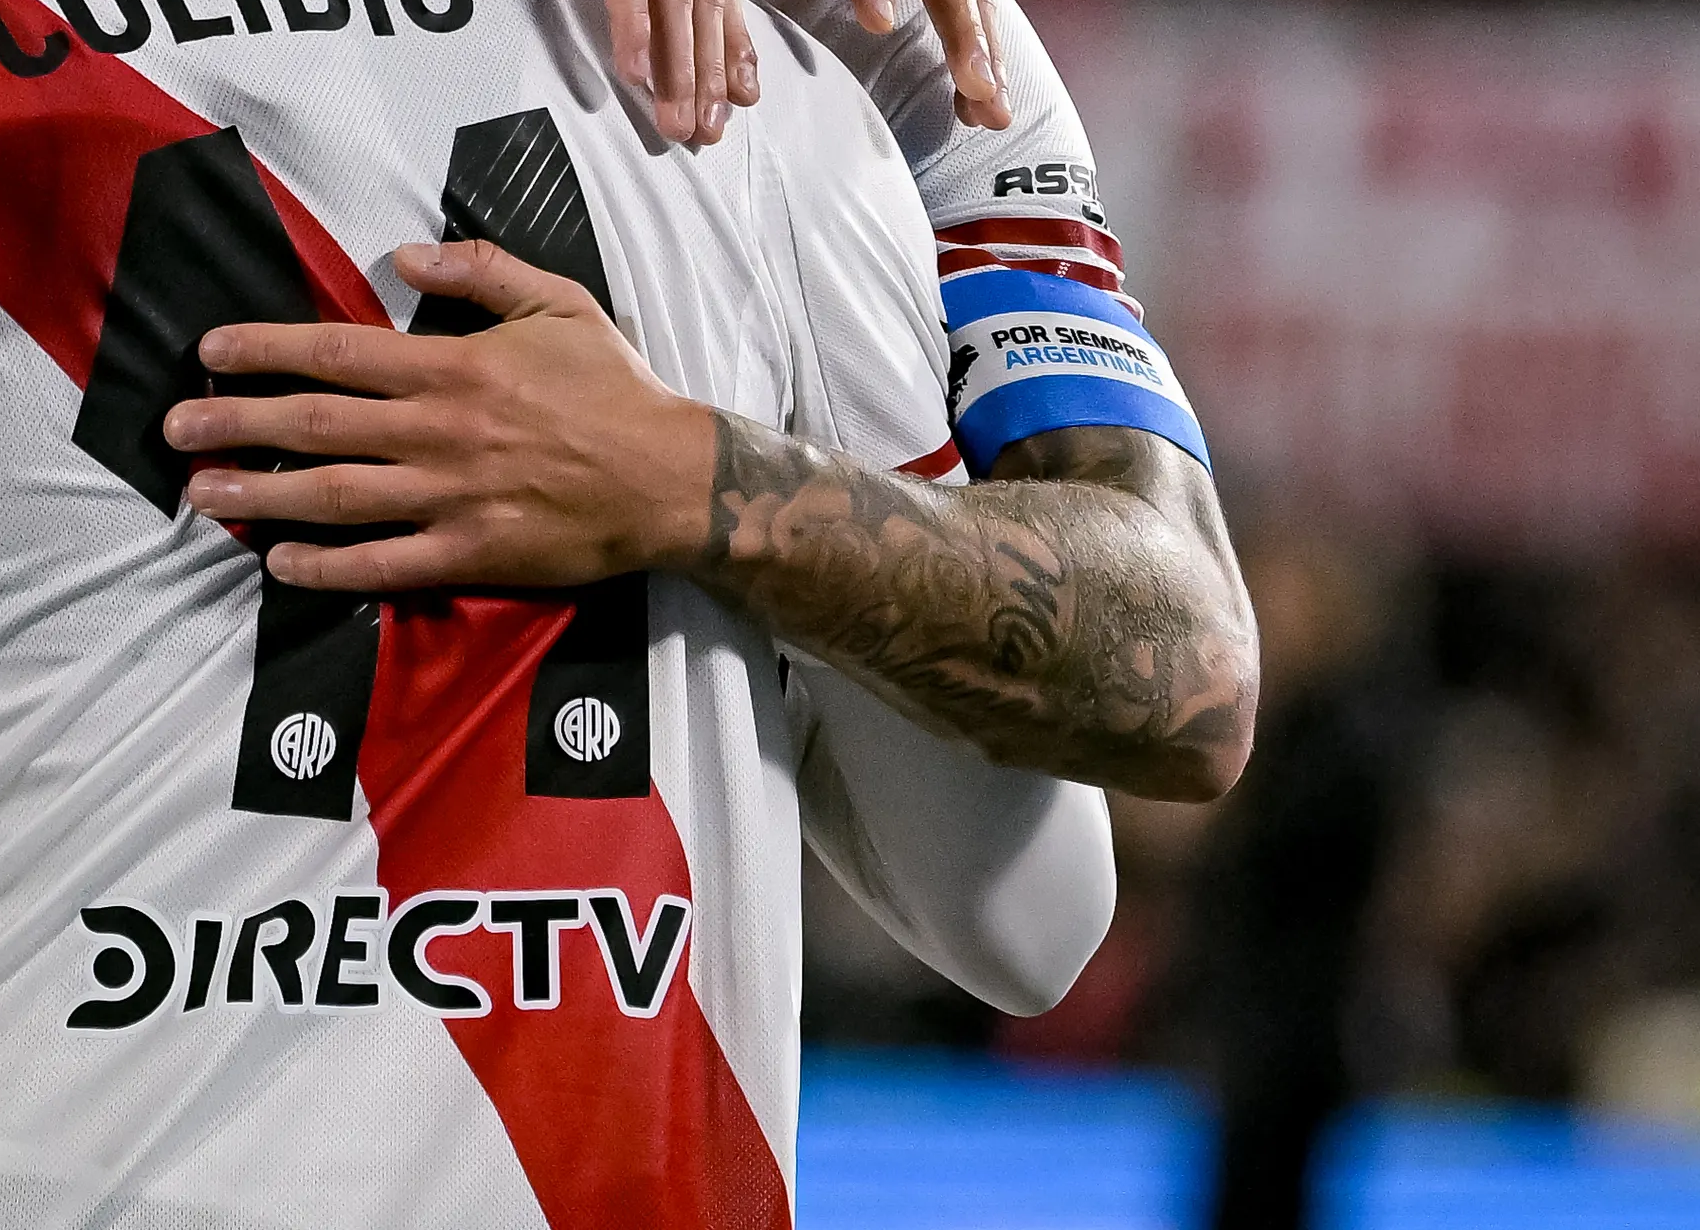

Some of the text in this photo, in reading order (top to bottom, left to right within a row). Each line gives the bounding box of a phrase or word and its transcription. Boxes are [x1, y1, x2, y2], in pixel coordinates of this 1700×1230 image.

[992, 326, 1152, 366] POR SIEMPRE
[1006, 346, 1163, 385] ARGENTINAS
[270, 712, 337, 780] CARP
[553, 697, 621, 762] CARP
[65, 892, 691, 1030] DIRECTV
